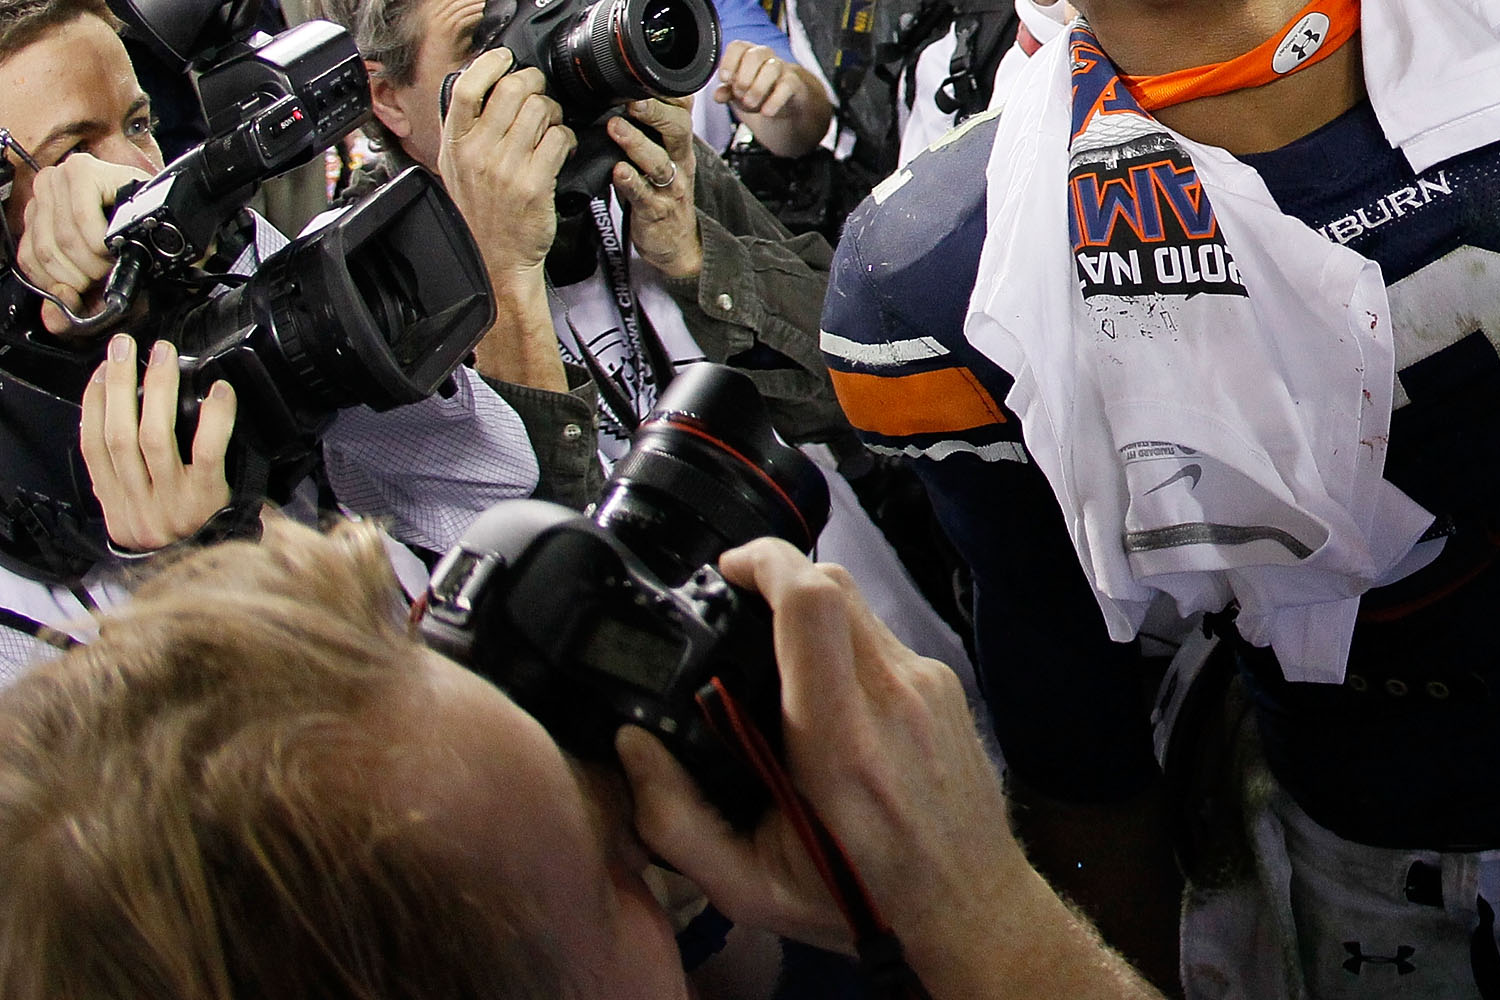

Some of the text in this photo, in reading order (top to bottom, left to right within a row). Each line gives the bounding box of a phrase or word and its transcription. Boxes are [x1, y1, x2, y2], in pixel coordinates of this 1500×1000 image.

[280, 116, 296, 130] SONY
[1317, 169, 1454, 245] BURN
[1077, 248, 1142, 293] NA
